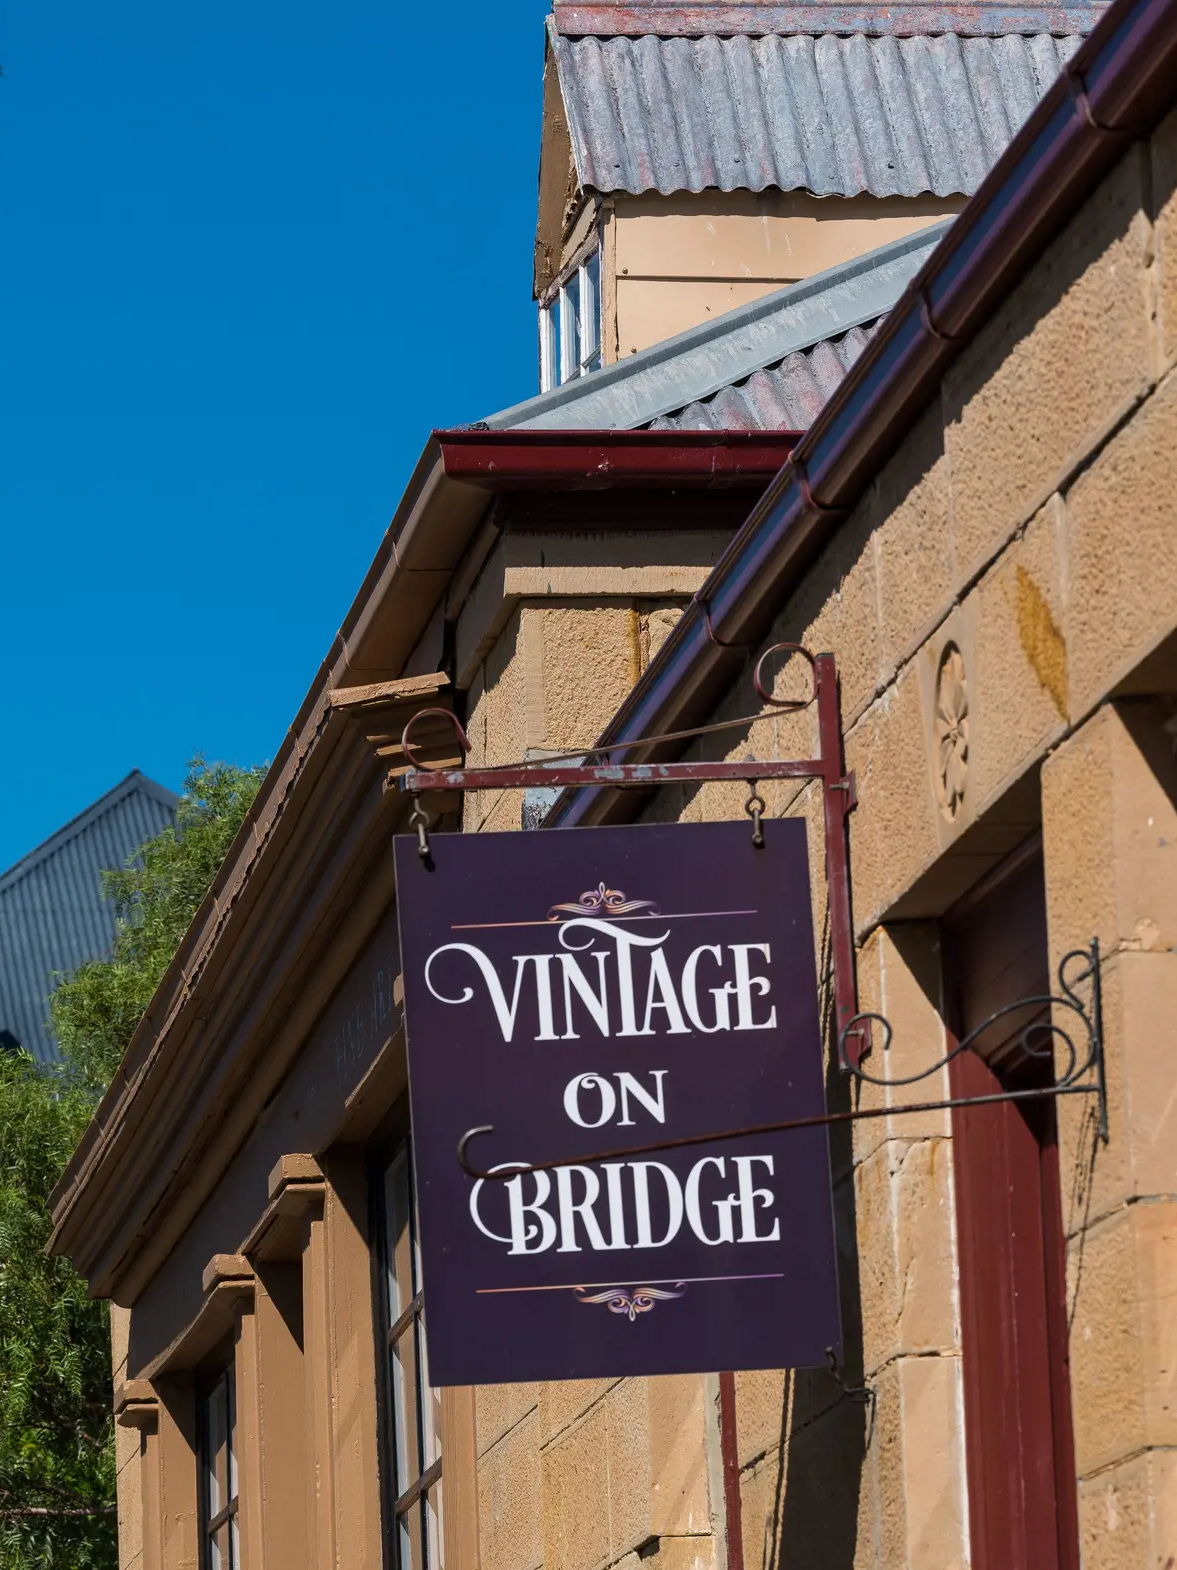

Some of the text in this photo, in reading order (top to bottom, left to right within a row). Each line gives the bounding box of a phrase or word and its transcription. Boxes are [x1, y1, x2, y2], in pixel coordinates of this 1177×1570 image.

[425, 917, 777, 1043] VINTAGE
[563, 1069, 670, 1128] ON
[469, 1154, 781, 1256] BRIDGE
